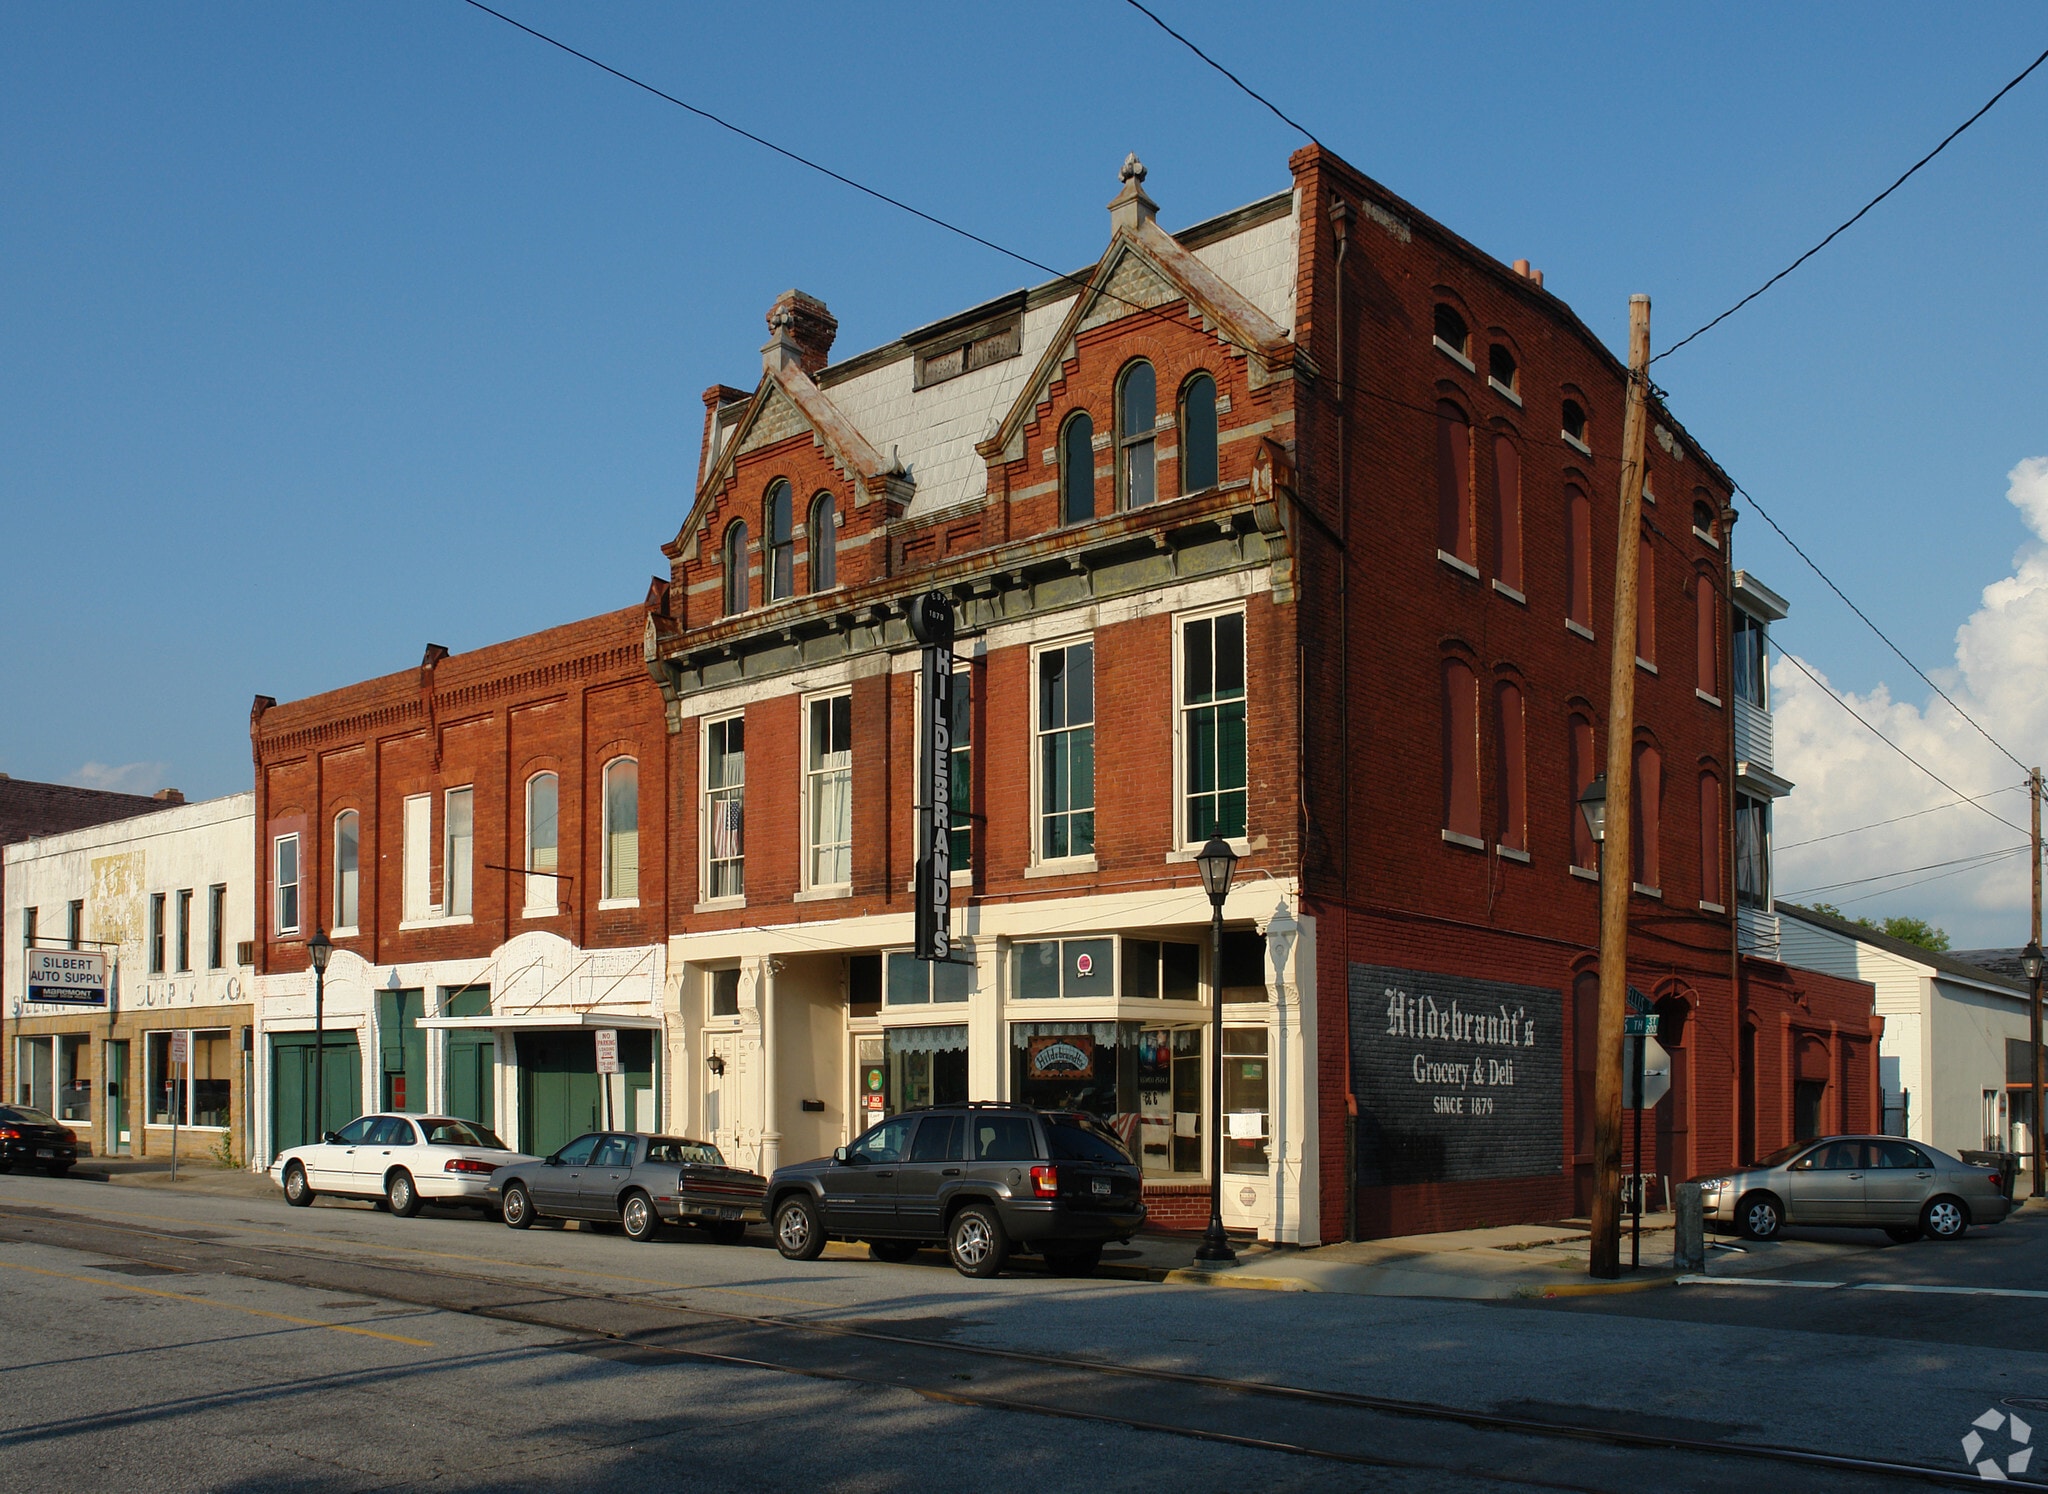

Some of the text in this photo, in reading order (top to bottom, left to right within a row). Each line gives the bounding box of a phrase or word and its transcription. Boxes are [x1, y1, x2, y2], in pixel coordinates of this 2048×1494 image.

[929, 609, 944, 621] 1879
[934, 647, 950, 958] HILDEBRANDT'S
[43, 957, 93, 970] SILBERT
[31, 970, 104, 984] AUTO SUPPLY
[1627, 988, 1646, 1012] ELLIS
[1384, 987, 1535, 1047] Hildebrandt's
[1648, 1016, 1656, 1025] ST
[1634, 1019, 1644, 1031] TH
[1645, 1025, 1657, 1034] 200
[1412, 1053, 1514, 1091] Grocery & Deli
[1433, 1096, 1493, 1116] SINCE 1879
